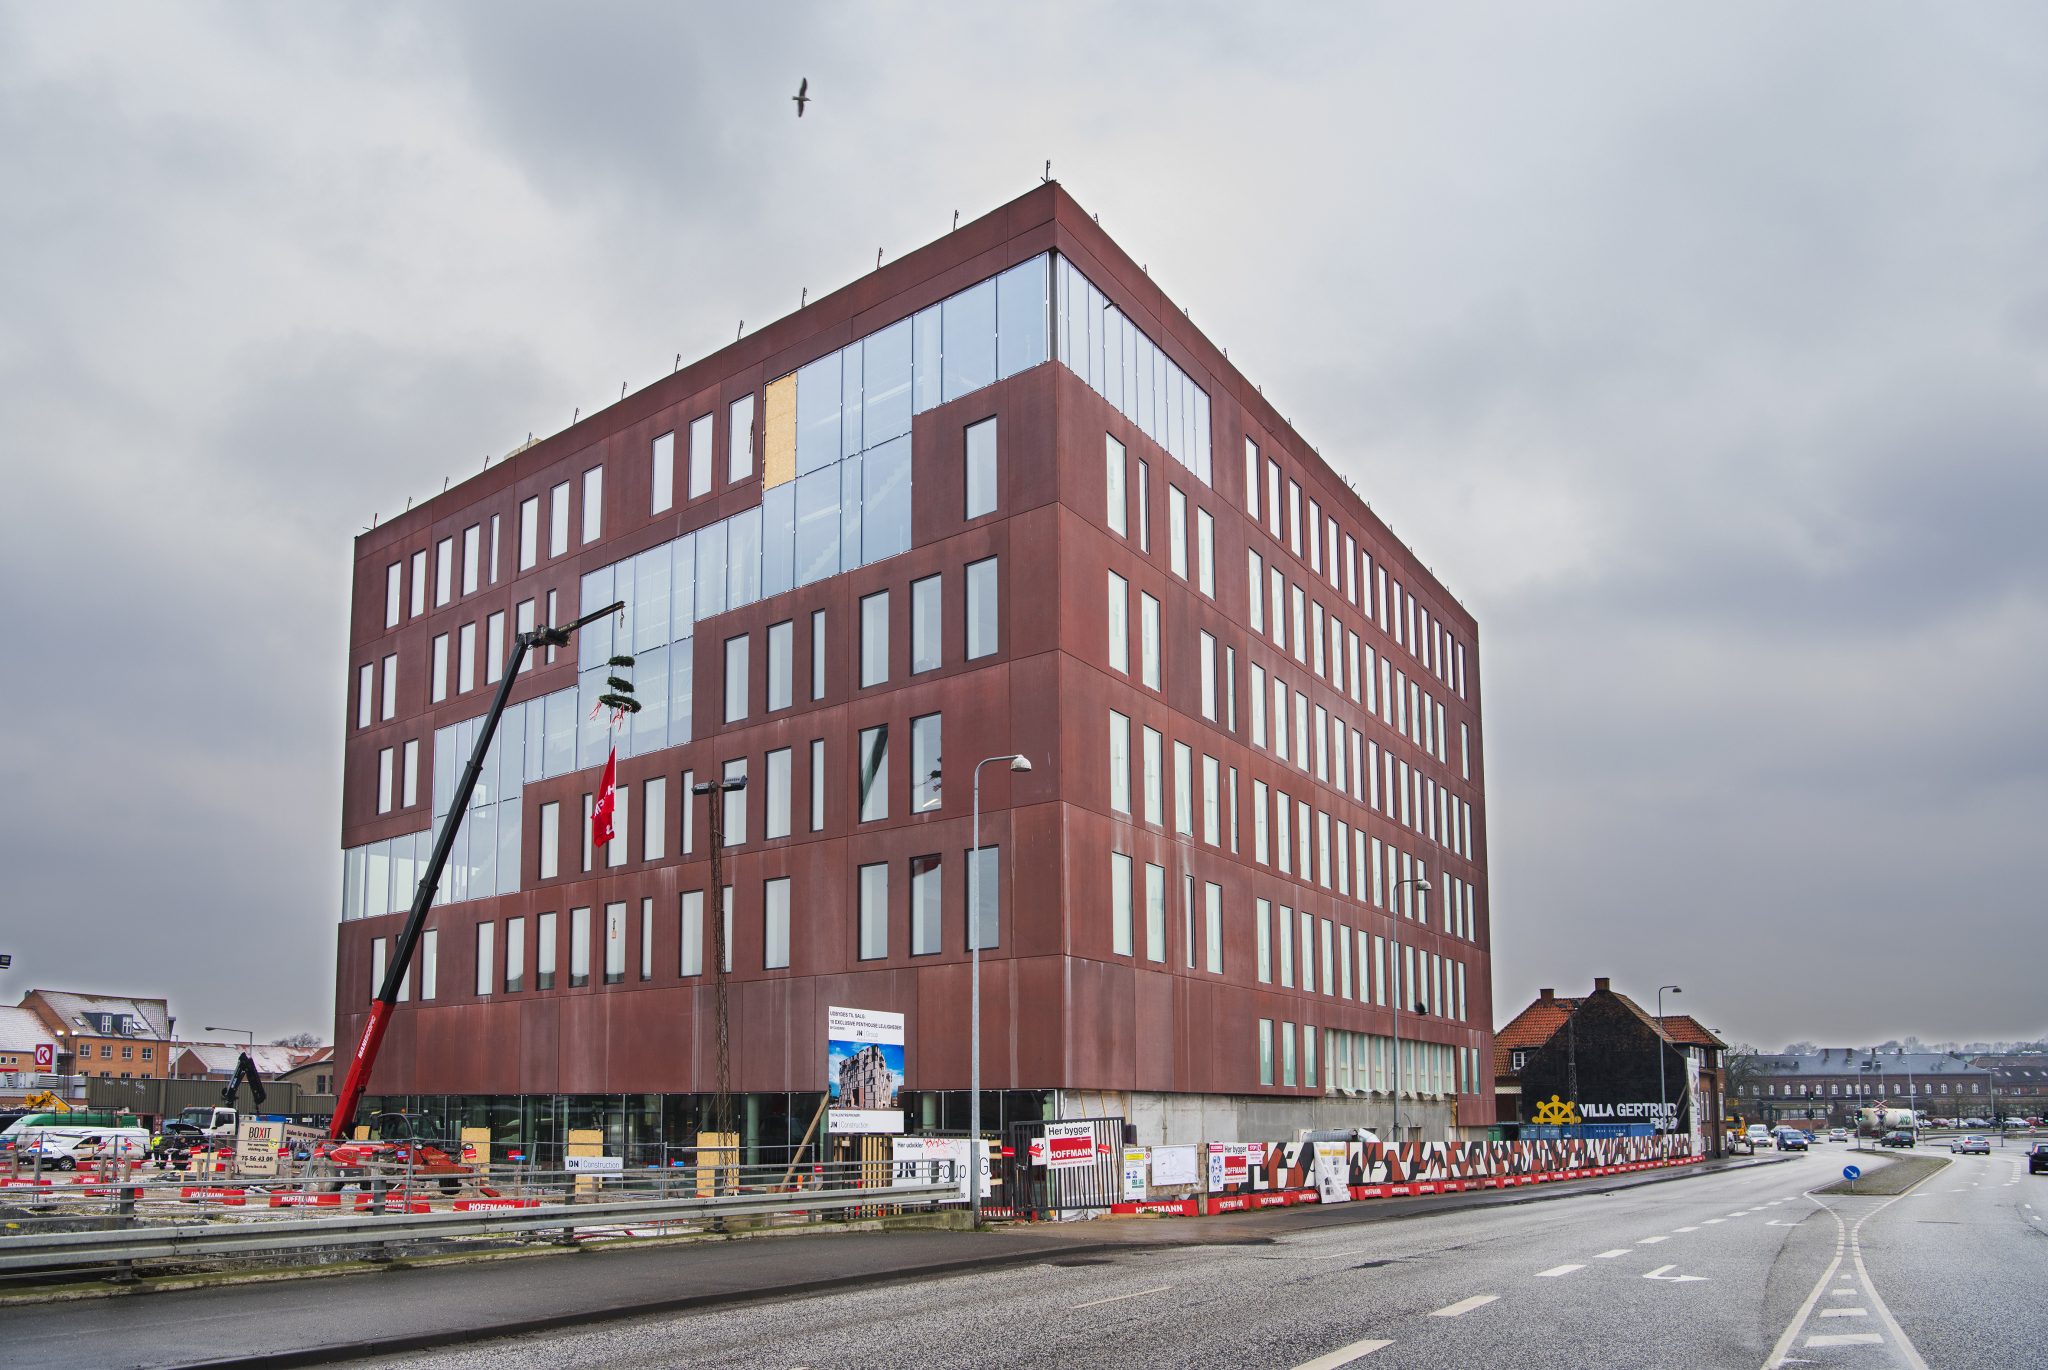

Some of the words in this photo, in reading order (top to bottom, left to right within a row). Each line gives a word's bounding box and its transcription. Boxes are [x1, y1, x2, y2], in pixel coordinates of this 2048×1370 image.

[1579, 1103, 1615, 1117] VILLA
[1616, 1102, 1678, 1117] GERTRUD
[248, 1126, 272, 1139] BOXIT
[1048, 1127, 1063, 1135] Her
[1064, 1126, 1091, 1136] bygger
[1050, 1147, 1093, 1158] HOFFMANN
